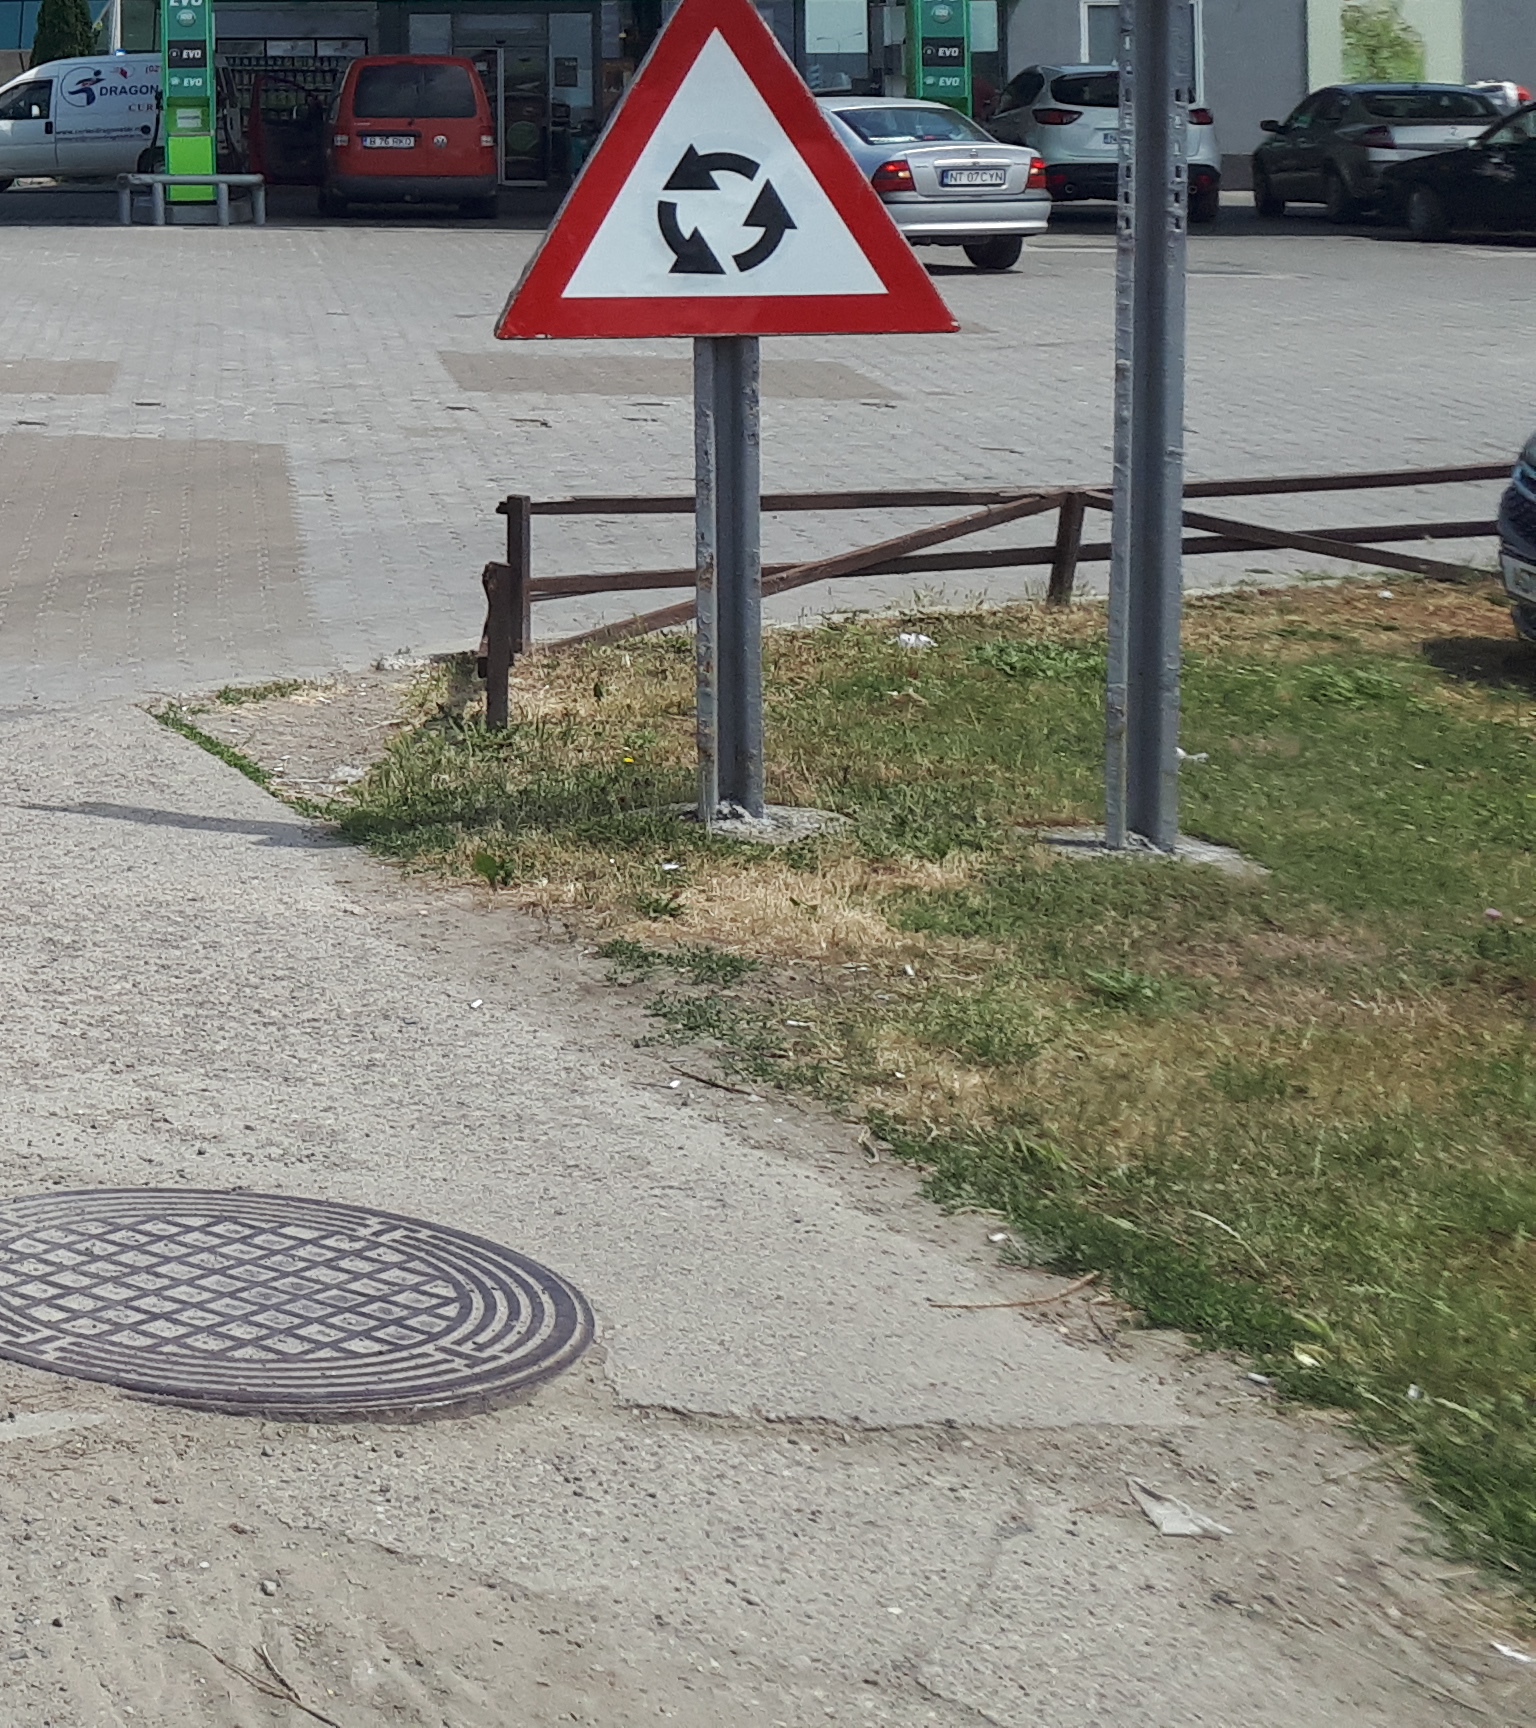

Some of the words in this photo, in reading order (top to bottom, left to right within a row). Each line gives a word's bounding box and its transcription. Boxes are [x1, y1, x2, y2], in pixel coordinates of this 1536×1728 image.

[182, 49, 202, 59] EVO
[938, 47, 959, 57] EVO
[183, 77, 203, 87] EVO
[939, 77, 960, 87] EVO
[380, 136, 390, 146] 76
[949, 172, 964, 183] NT
[967, 172, 980, 183] 07
[981, 171, 1003, 183] CYN
